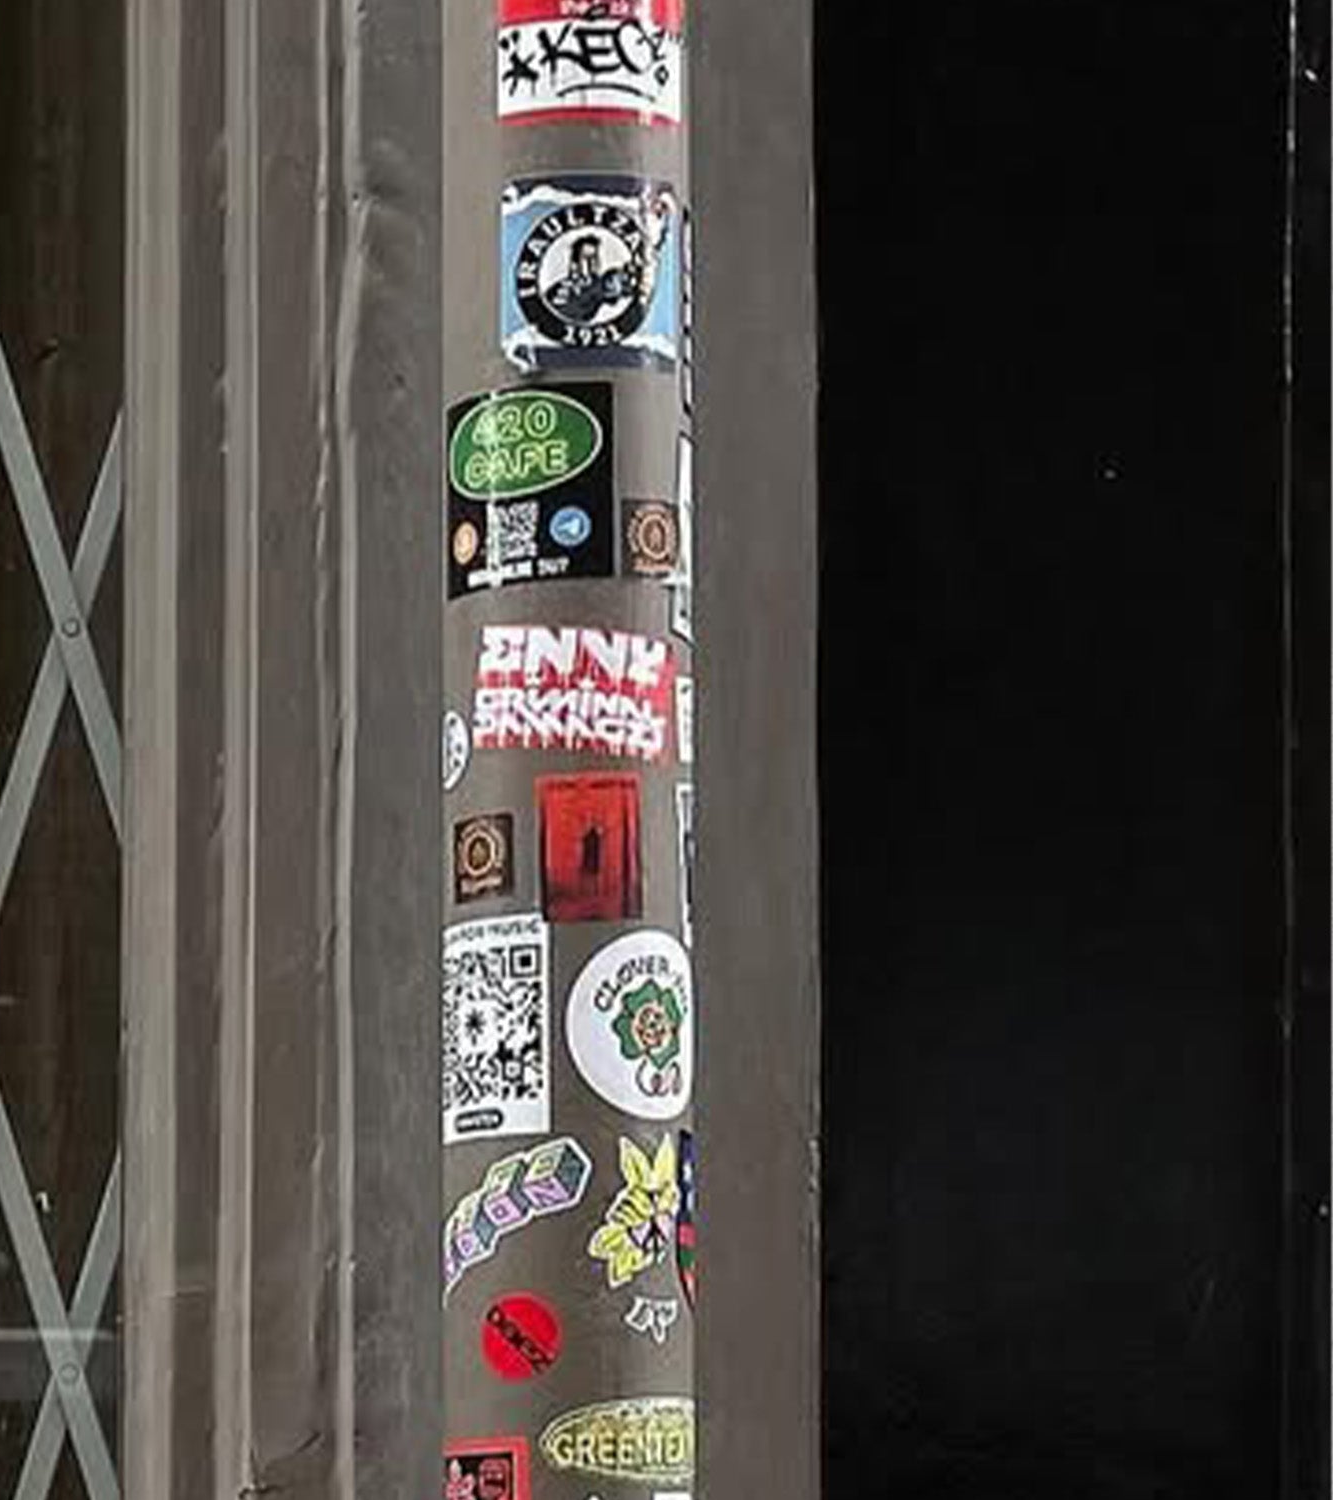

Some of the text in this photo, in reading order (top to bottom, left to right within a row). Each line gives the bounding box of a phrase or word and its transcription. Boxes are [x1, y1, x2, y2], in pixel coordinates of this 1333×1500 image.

[562, 323, 623, 345] 1921
[471, 400, 558, 447] 420
[593, 955, 670, 1013] CLOVER
